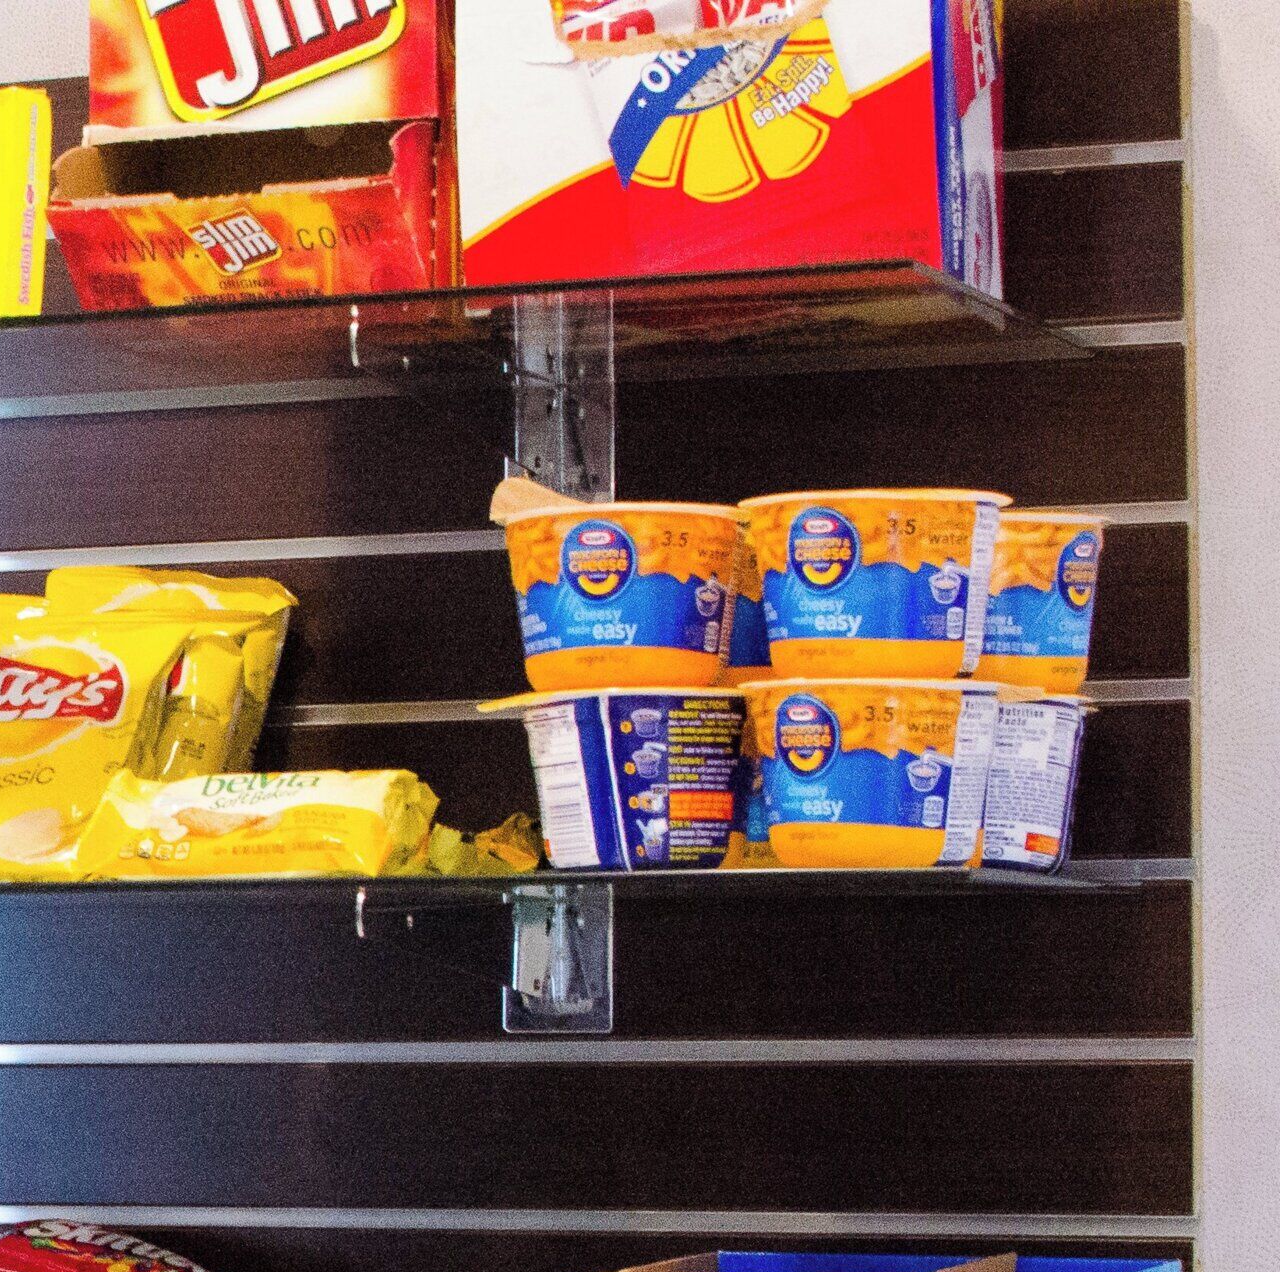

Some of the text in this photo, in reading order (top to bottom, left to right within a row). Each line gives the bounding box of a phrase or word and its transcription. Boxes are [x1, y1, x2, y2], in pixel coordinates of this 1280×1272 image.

[771, 57, 834, 118] Happy!
[886, 517, 917, 535] 3.5
[661, 530, 689, 548] 3.5
[928, 533, 968, 546] water
[591, 622, 638, 646] easy
[814, 613, 863, 637] easy
[863, 705, 894, 723] 3.5
[998, 705, 1045, 719] Nutrition
[907, 722, 953, 734] water
[801, 799, 844, 822] easy
